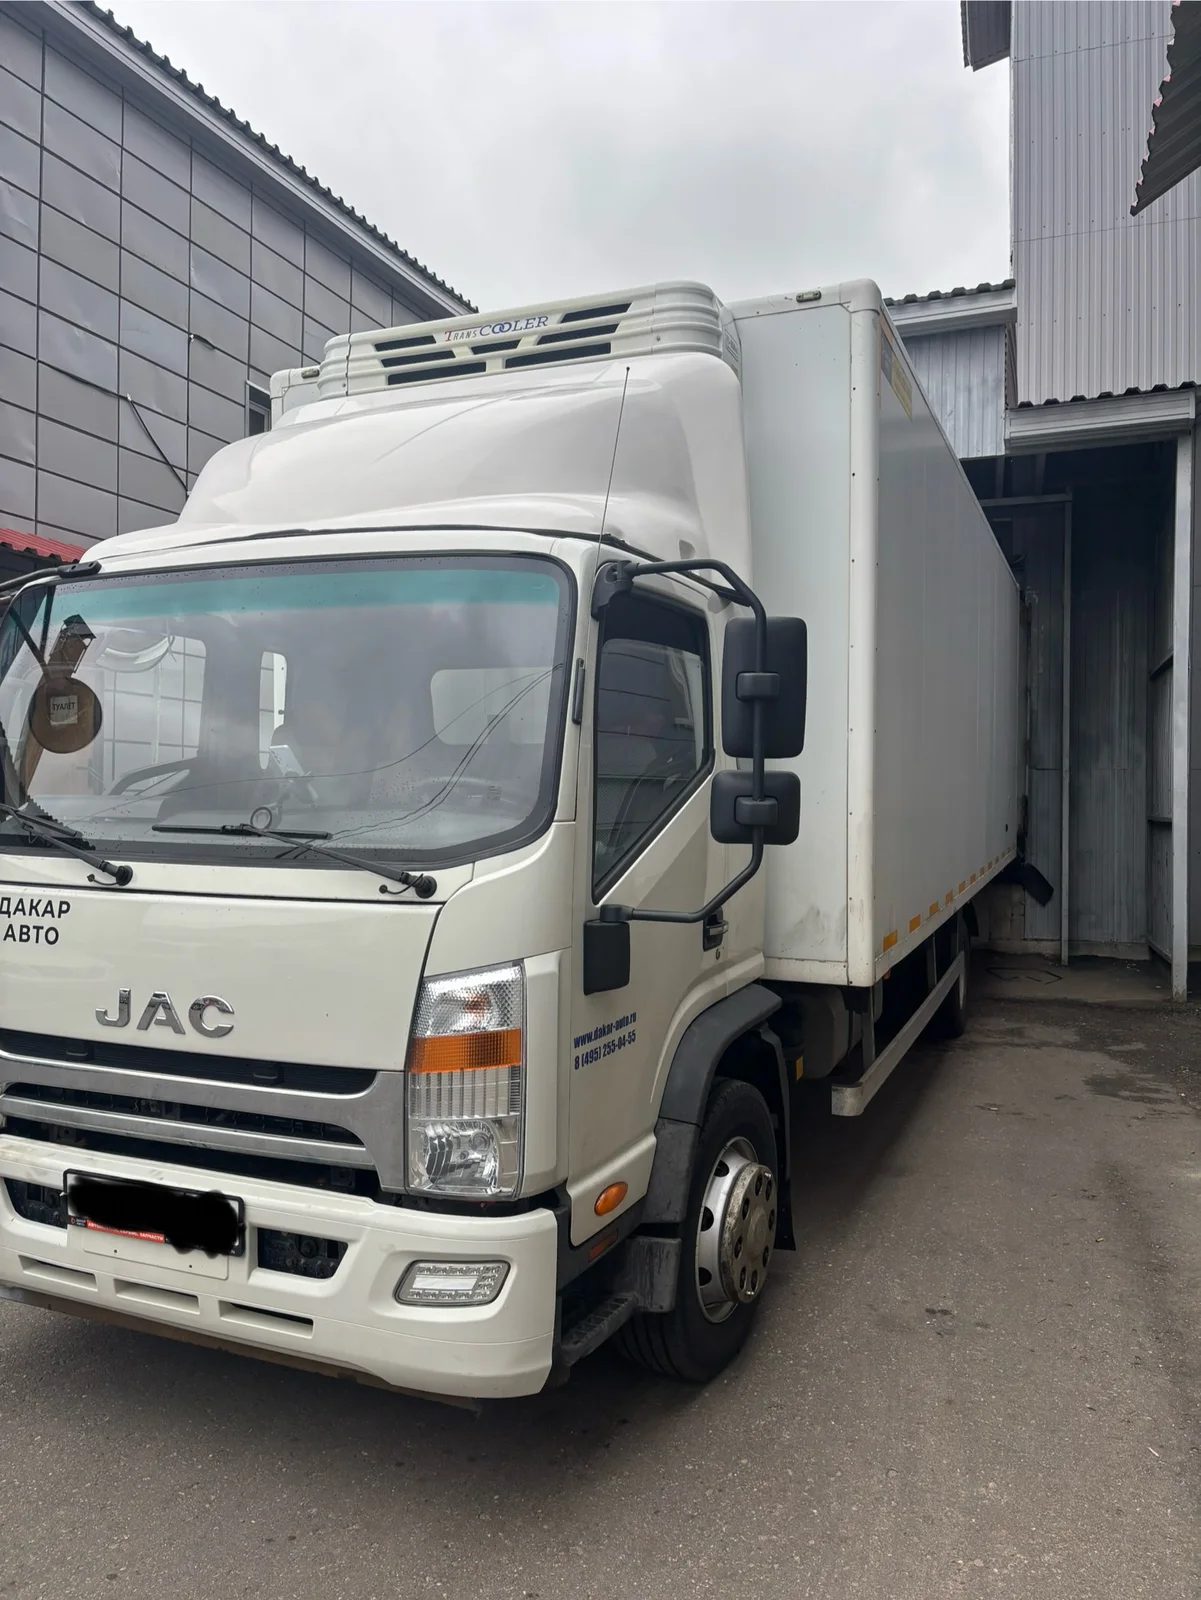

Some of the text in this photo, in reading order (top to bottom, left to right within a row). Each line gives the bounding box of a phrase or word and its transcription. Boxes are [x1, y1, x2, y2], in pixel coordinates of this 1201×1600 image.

[53, 702, 75, 711] ТУАЛЕТ
[0, 897, 71, 919] ДАКАР
[3, 923, 60, 946] АВТО
[95, 987, 235, 1039] JAC
[573, 1011, 637, 1049] www.dakar-auto.ru
[574, 1029, 637, 1071] 8 (495) 255-04-55
